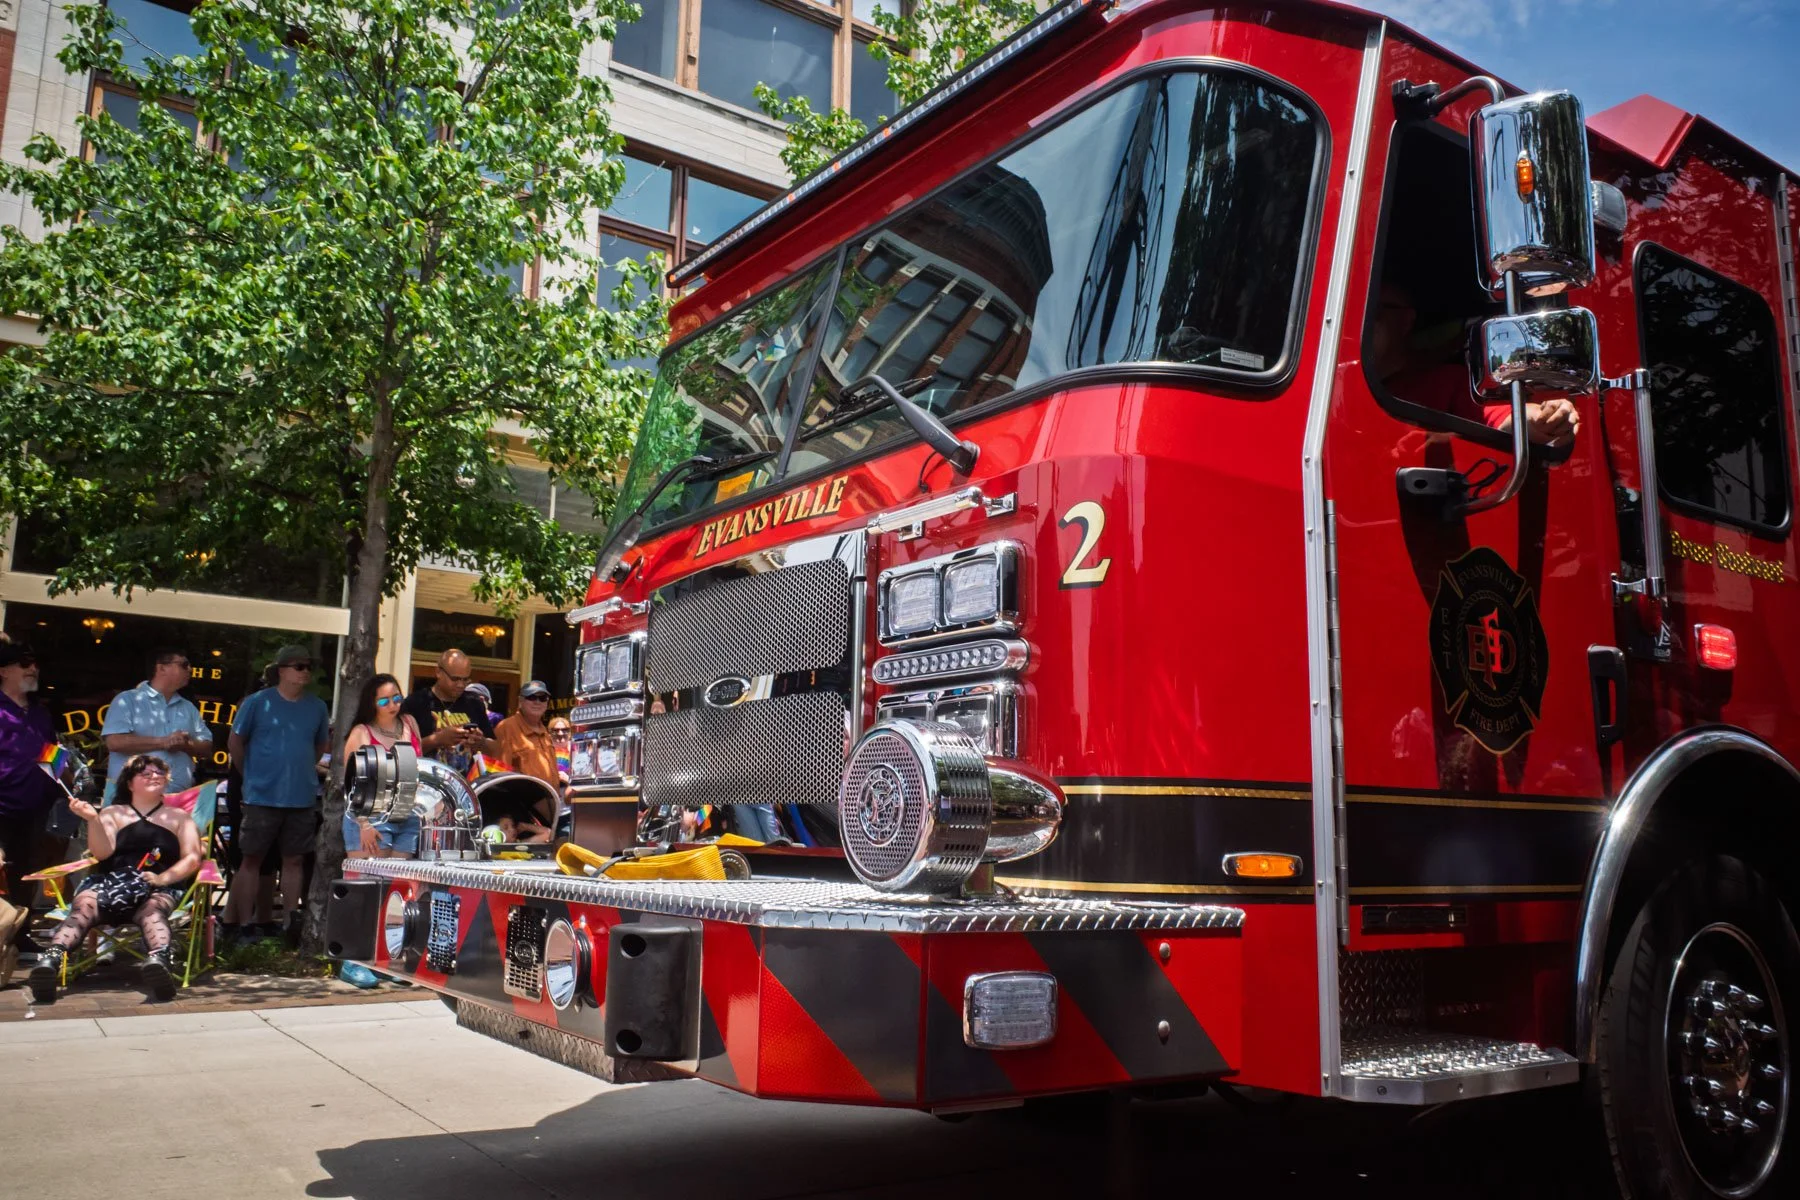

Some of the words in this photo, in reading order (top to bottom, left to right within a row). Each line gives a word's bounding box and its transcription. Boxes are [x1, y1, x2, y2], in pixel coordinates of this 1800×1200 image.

[695, 475, 849, 557] EVANSVILLE
[1058, 500, 1112, 590] 2
[1458, 564, 1516, 592] EVANSVILLE
[191, 667, 222, 680] HE
[1469, 708, 1493, 731] FIRE
